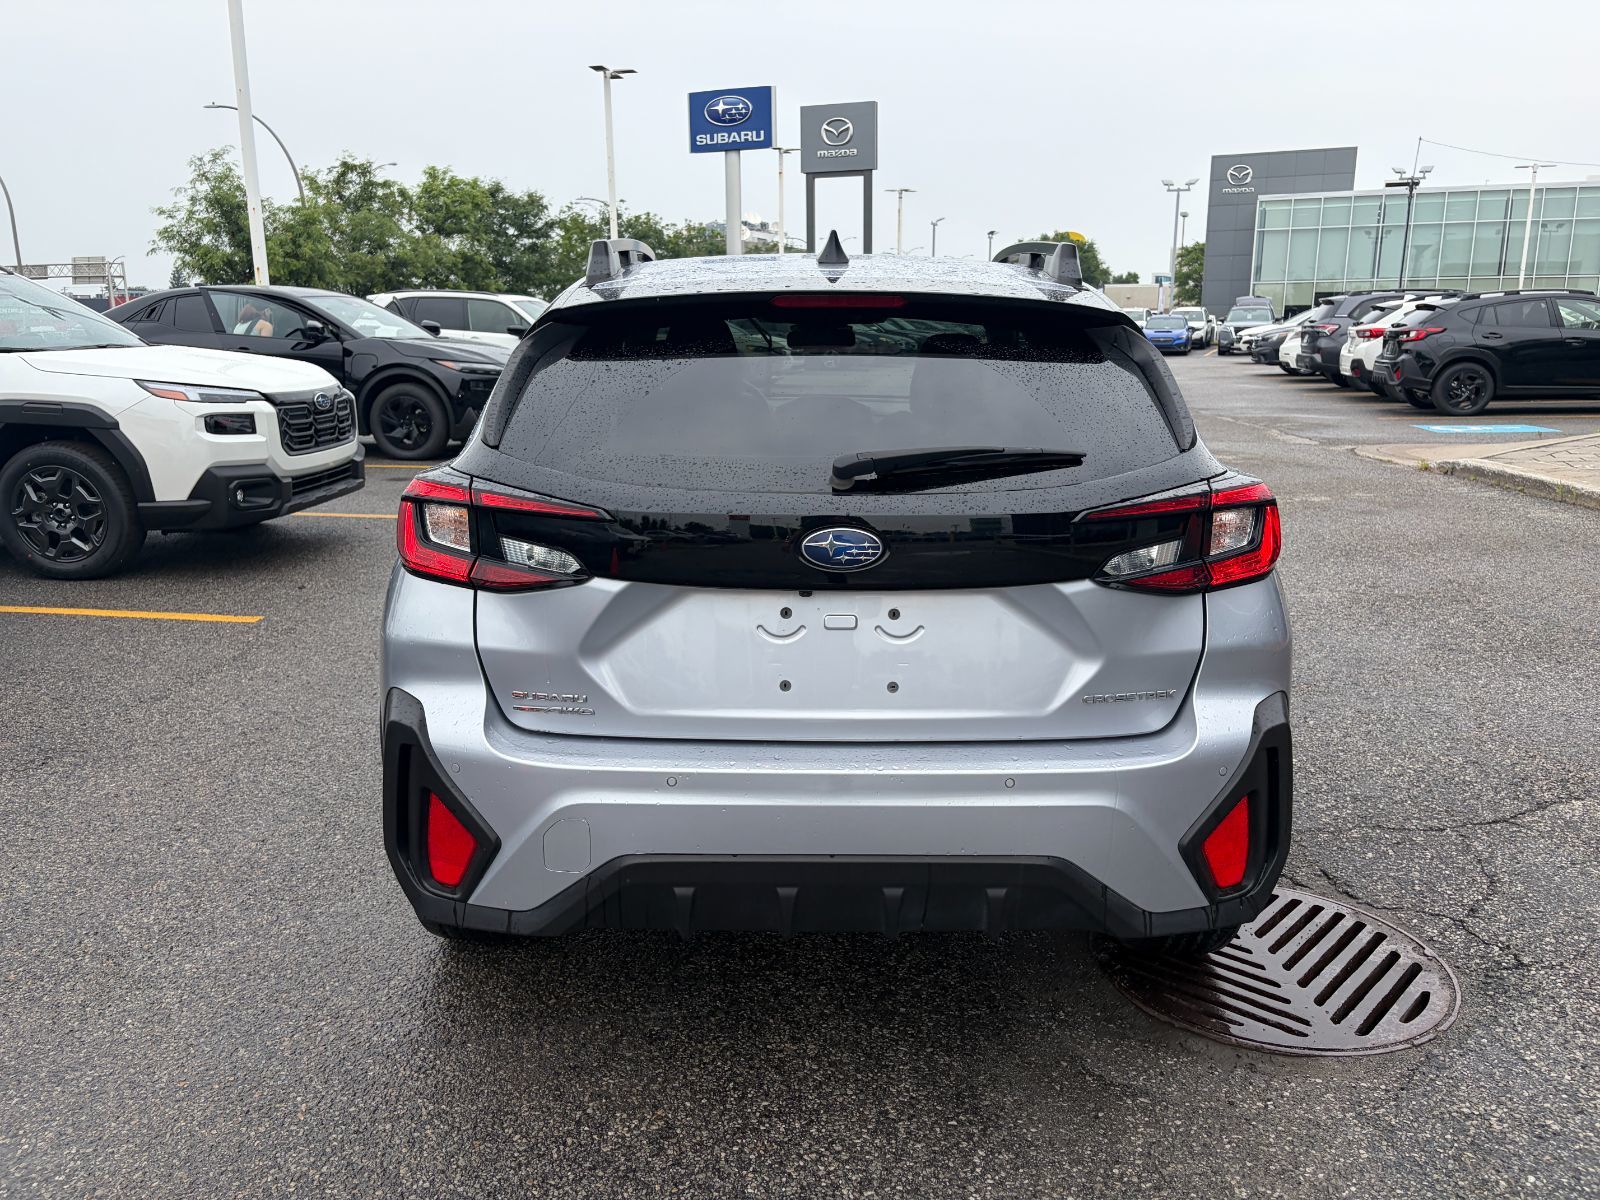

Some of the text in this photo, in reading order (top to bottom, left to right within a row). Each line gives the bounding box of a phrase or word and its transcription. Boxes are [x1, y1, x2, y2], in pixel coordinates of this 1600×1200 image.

[696, 130, 765, 146] SUBARU
[511, 690, 588, 703] SUBARU
[1081, 689, 1177, 705] CROSSTREK
